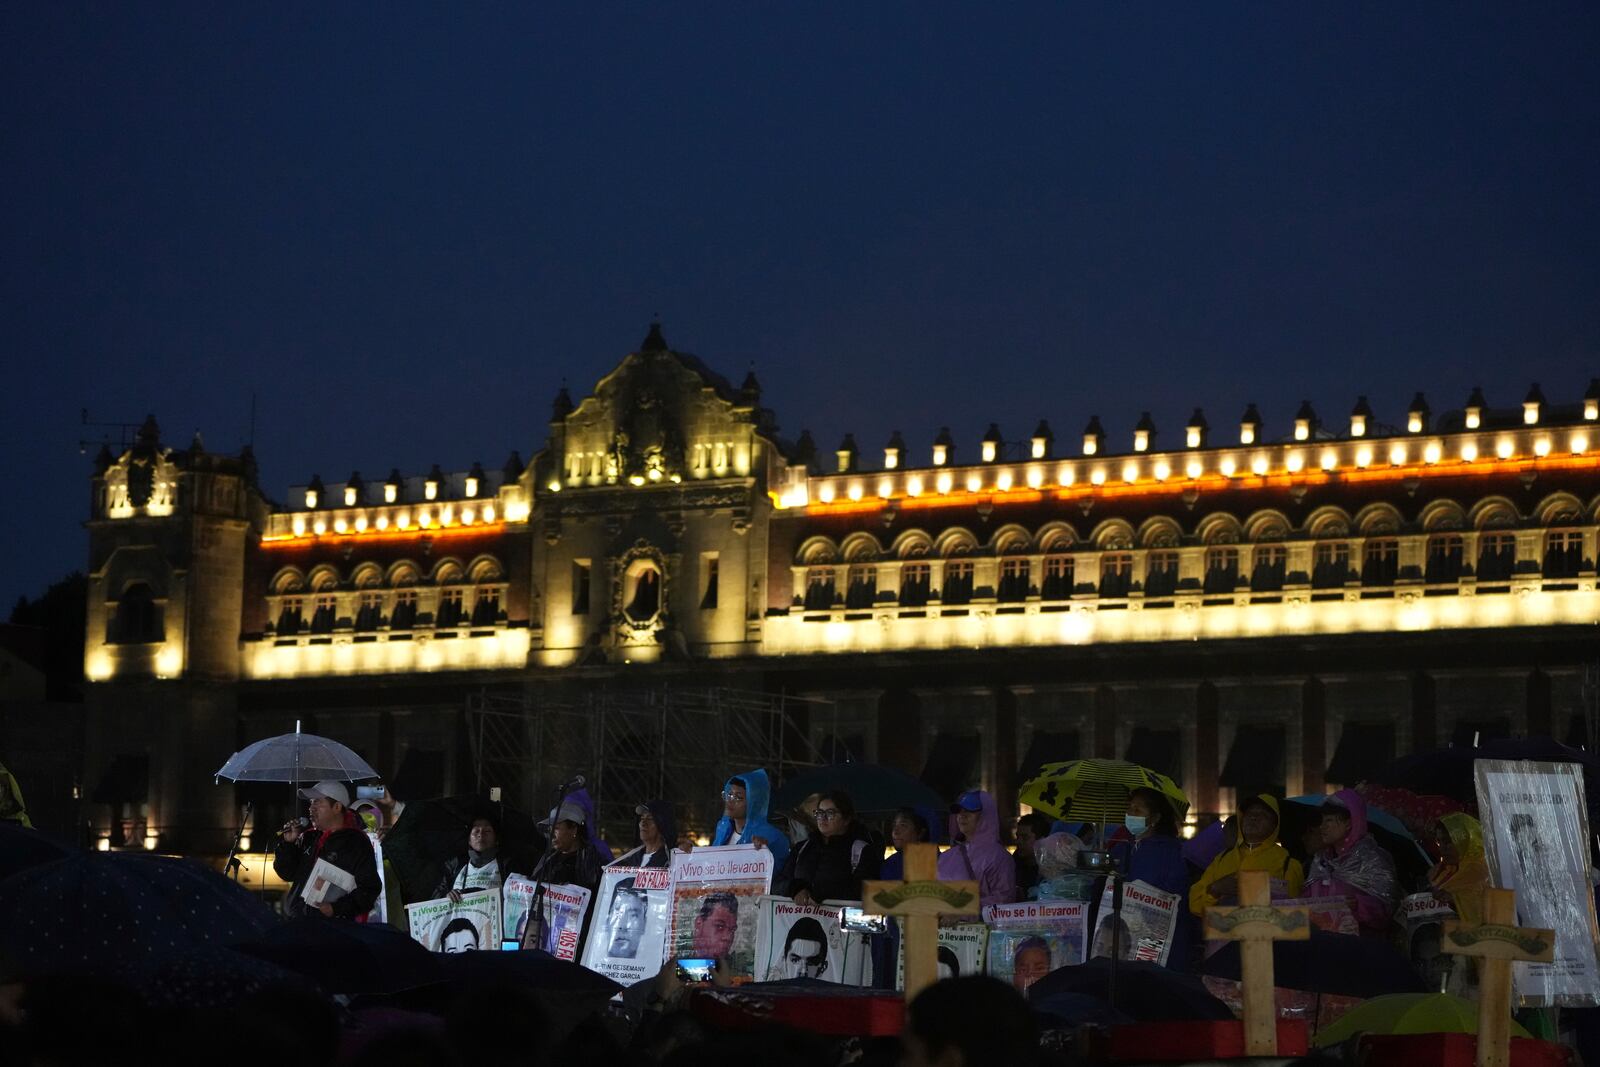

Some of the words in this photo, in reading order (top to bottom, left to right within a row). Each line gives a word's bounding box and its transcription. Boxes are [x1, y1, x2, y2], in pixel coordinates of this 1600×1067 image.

[680, 863, 703, 879] ¡Vivo
[706, 866, 715, 875] se
[718, 862, 726, 874] lo
[728, 860, 767, 874] llevaron!
[1126, 886, 1172, 910] llevaron!
[418, 905, 438, 916] ¡Vivo
[775, 904, 793, 915] ¡Vivo
[795, 906, 802, 914] se
[803, 905, 811, 914] lo
[1013, 908, 1024, 918] se
[1028, 906, 1036, 917] lo
[1040, 905, 1081, 917] llevaron!
[945, 931, 979, 942] llevaron!
